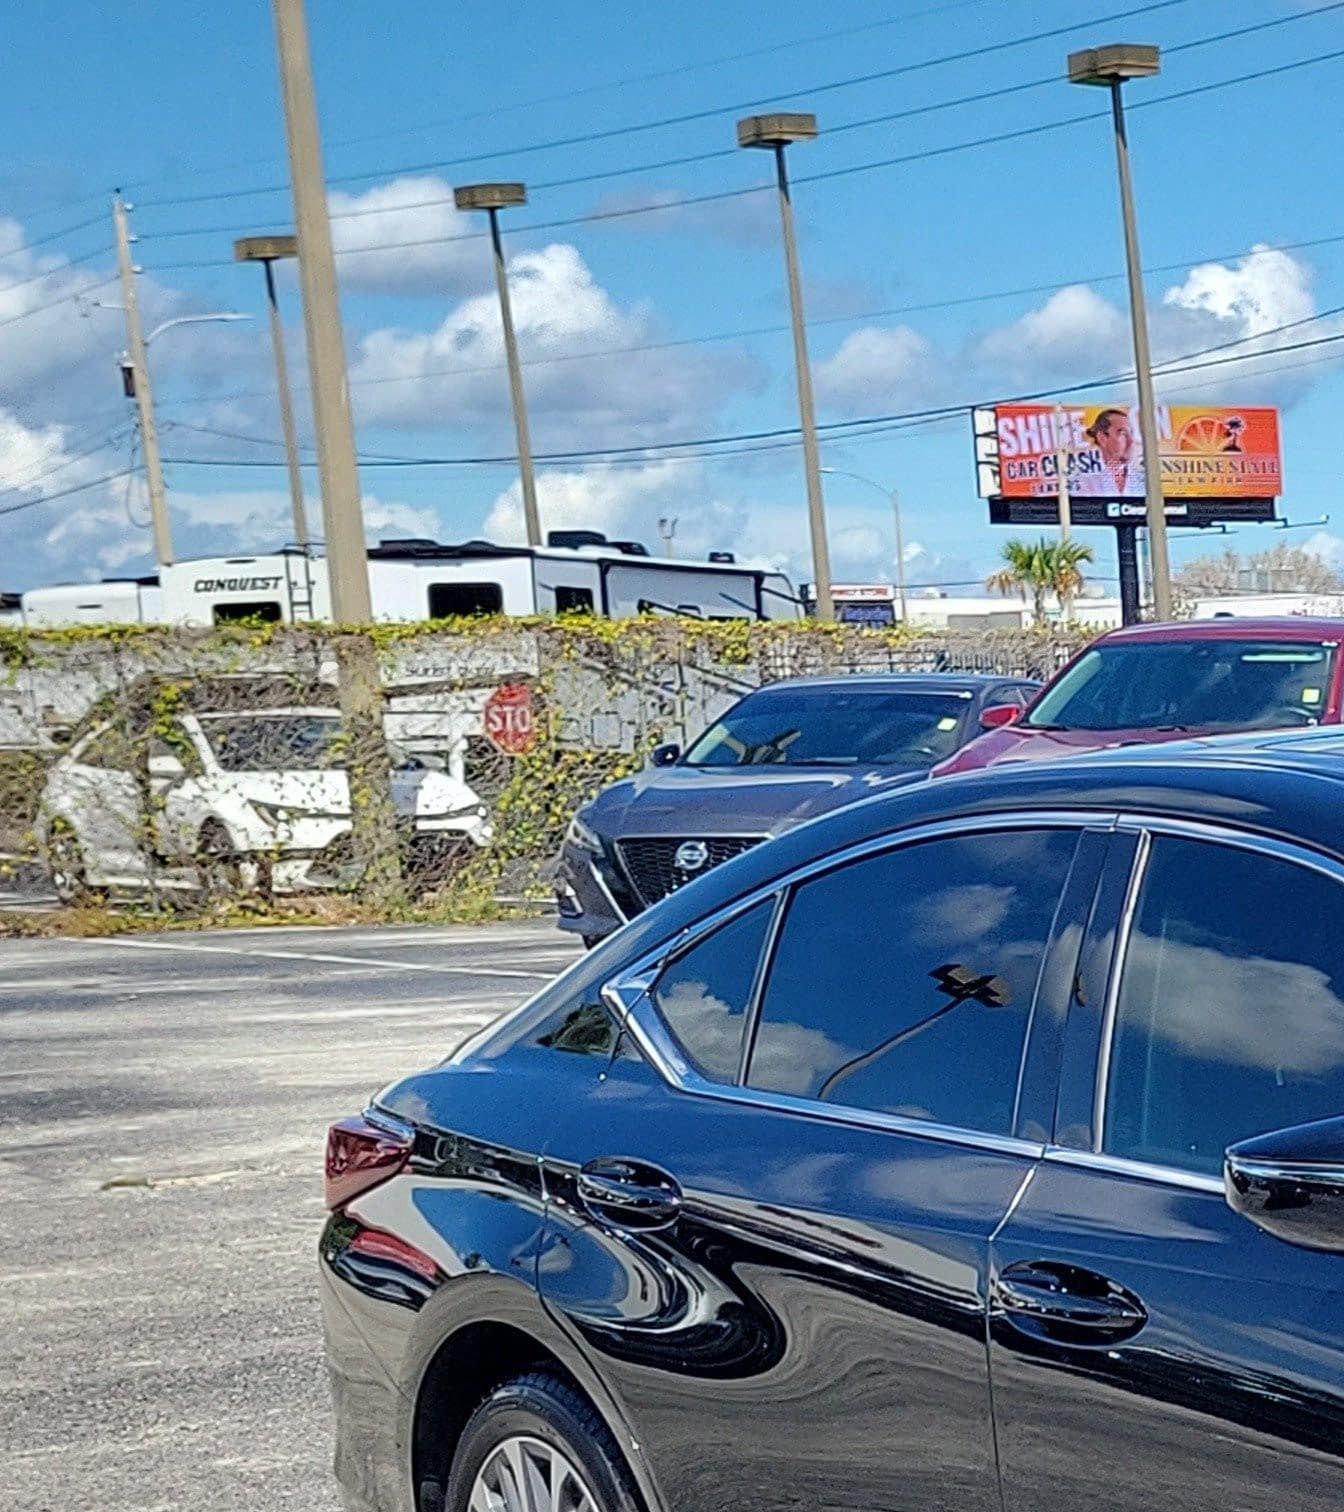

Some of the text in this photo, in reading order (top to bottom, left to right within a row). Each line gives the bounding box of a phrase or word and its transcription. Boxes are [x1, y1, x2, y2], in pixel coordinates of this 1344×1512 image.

[1007, 450, 1101, 479] CAR CASH
[1141, 460, 1225, 475] NSHINE
[194, 576, 283, 592] CONQUEST
[488, 705, 531, 733] STO
